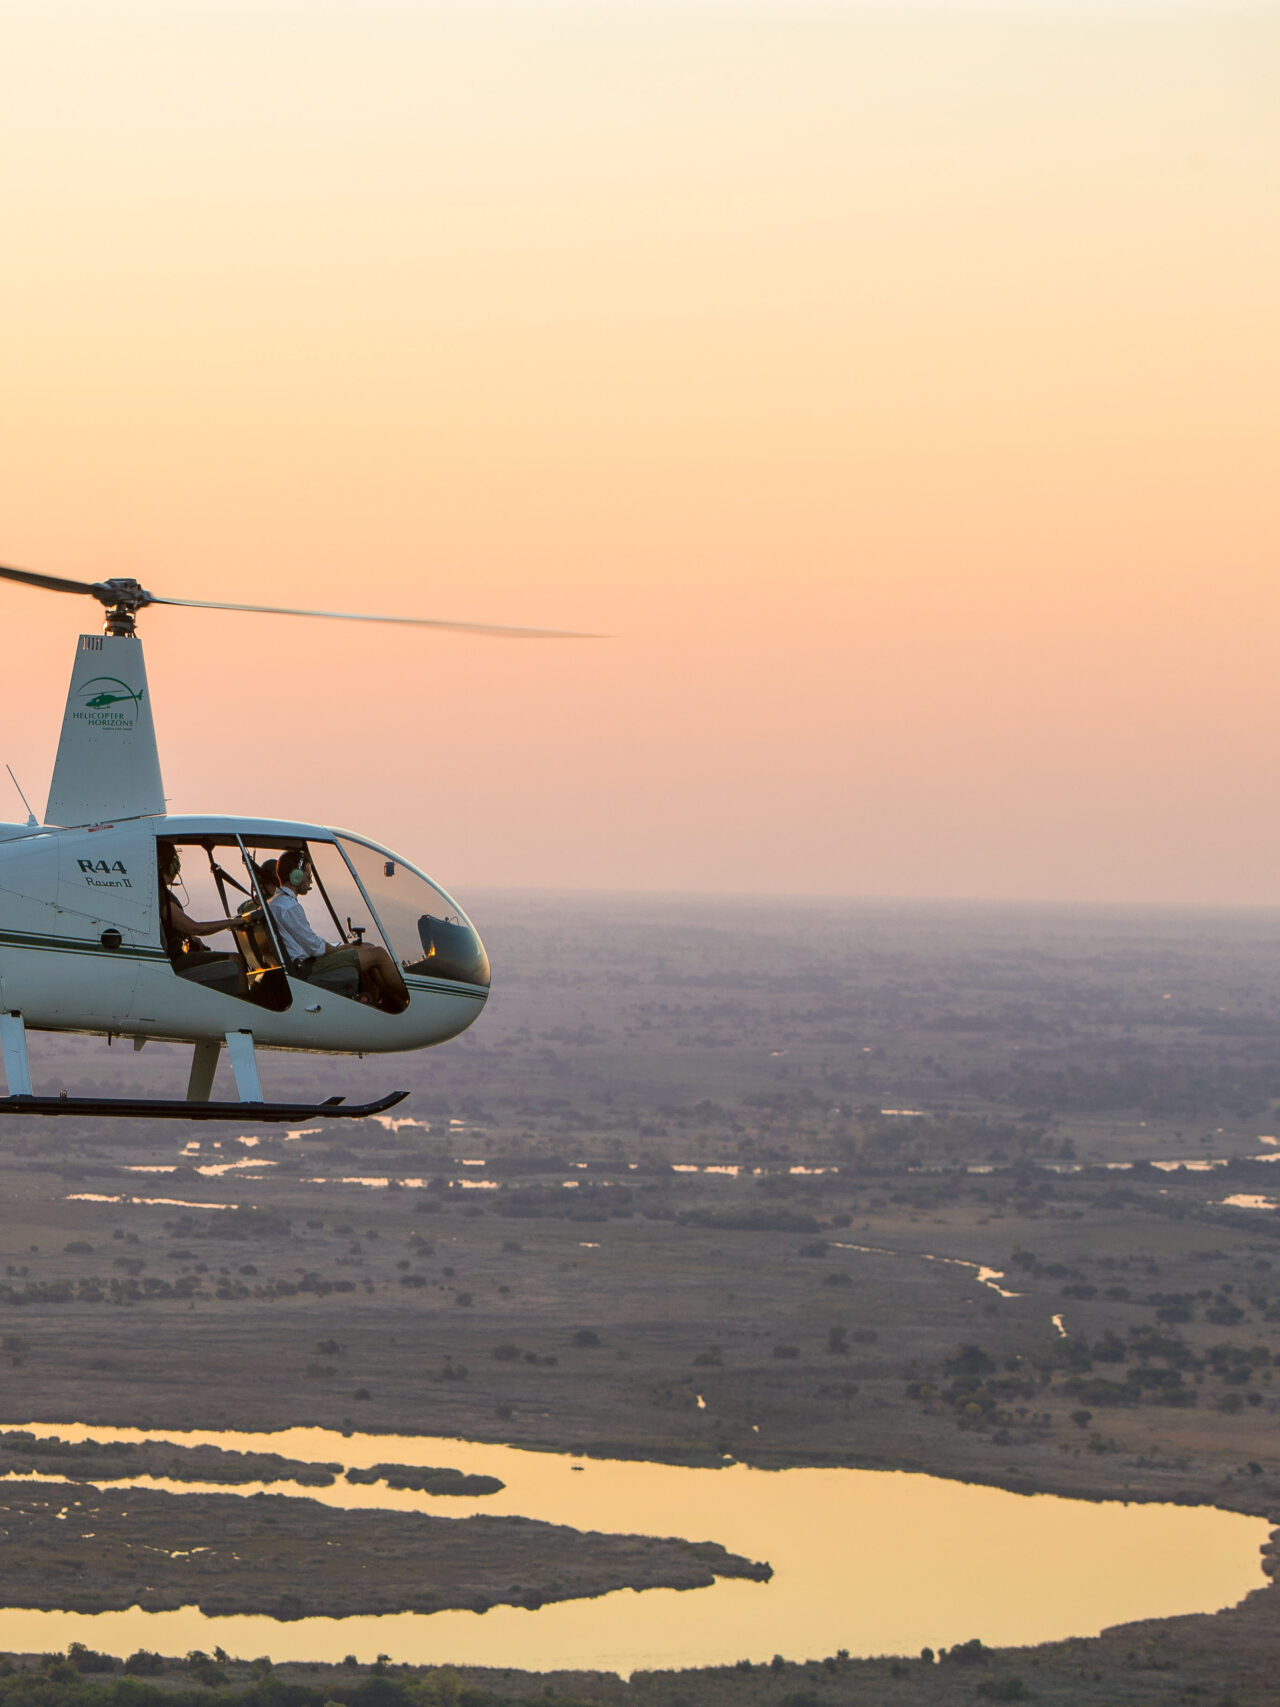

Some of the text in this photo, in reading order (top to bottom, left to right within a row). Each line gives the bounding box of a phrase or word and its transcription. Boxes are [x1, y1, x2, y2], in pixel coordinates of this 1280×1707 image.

[72, 712, 125, 720] HELICOPTER
[88, 719, 134, 727] HORIZONS
[77, 859, 128, 875] R44
[85, 876, 123, 888] Raven
